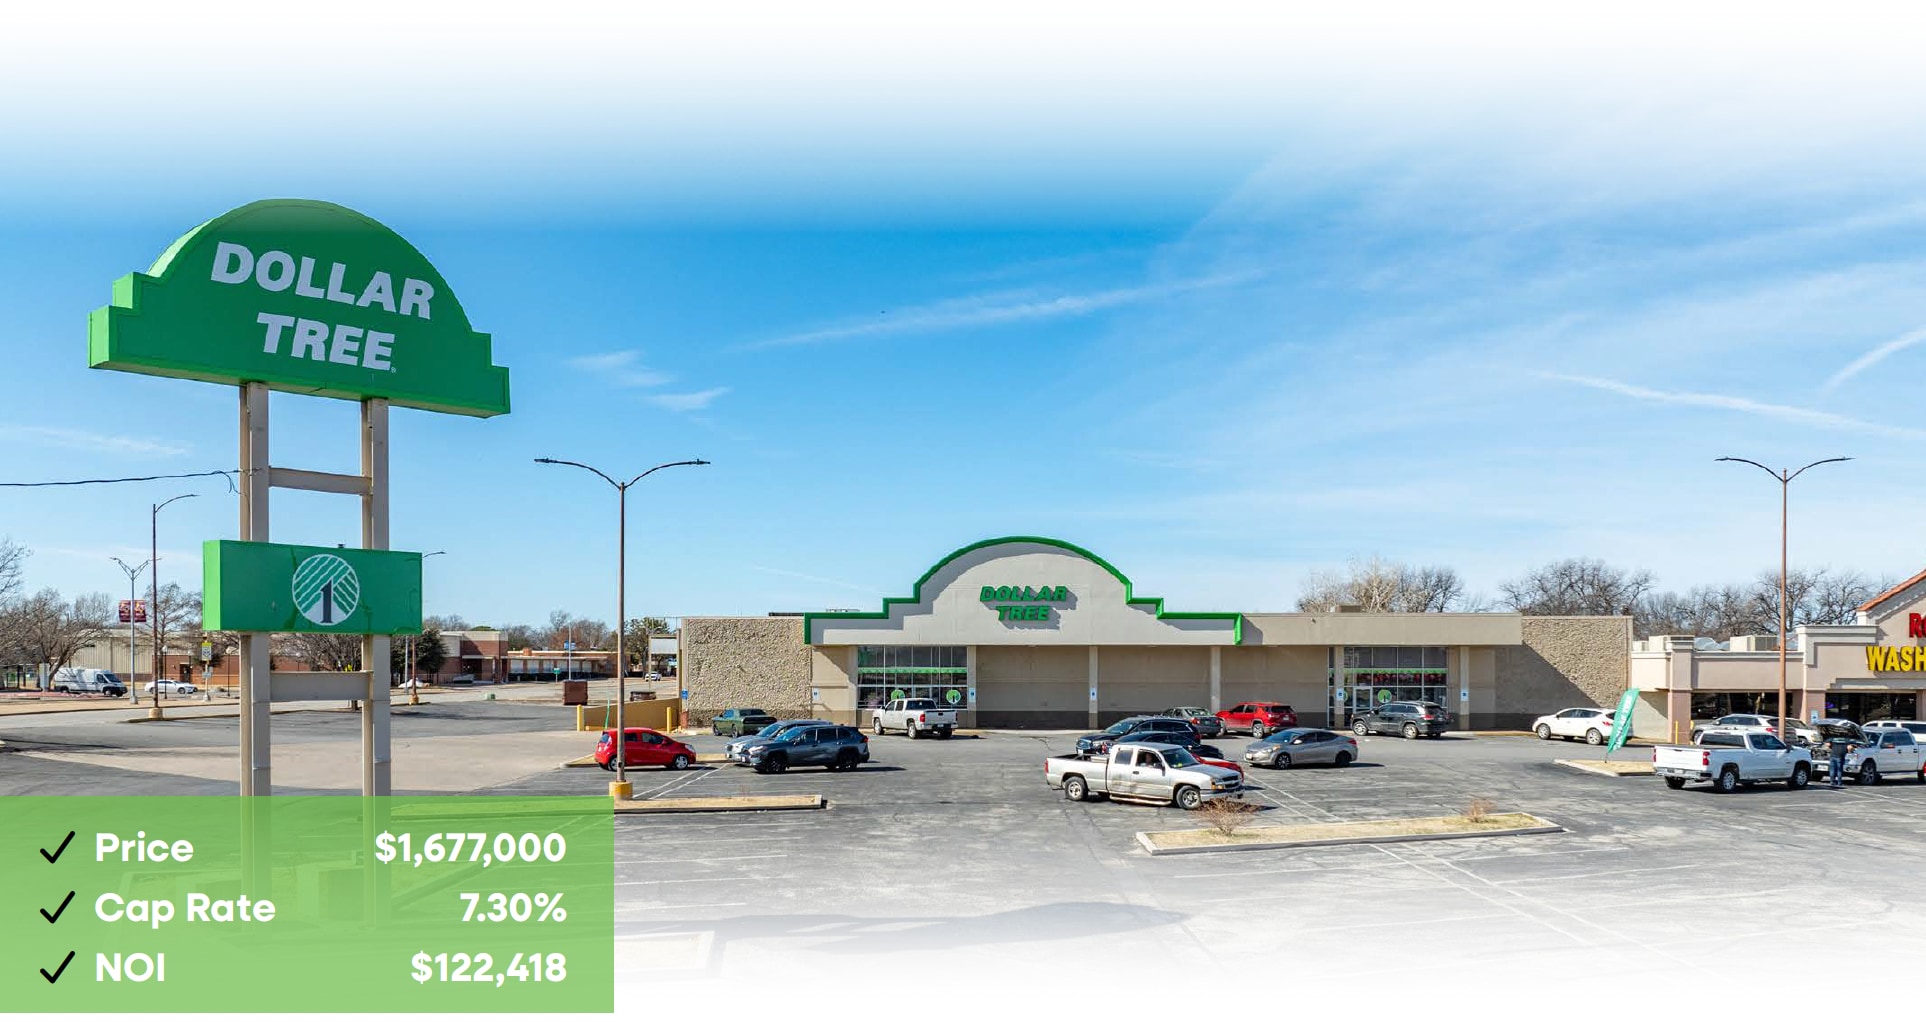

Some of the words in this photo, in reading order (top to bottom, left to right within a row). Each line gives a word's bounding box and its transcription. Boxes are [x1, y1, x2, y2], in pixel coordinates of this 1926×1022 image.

[210, 241, 435, 320] DOLLAR
[256, 311, 396, 371] TREE
[980, 585, 1067, 602] DOLLAR
[995, 605, 1050, 621] TREE
[1866, 645, 1926, 672] WASH
